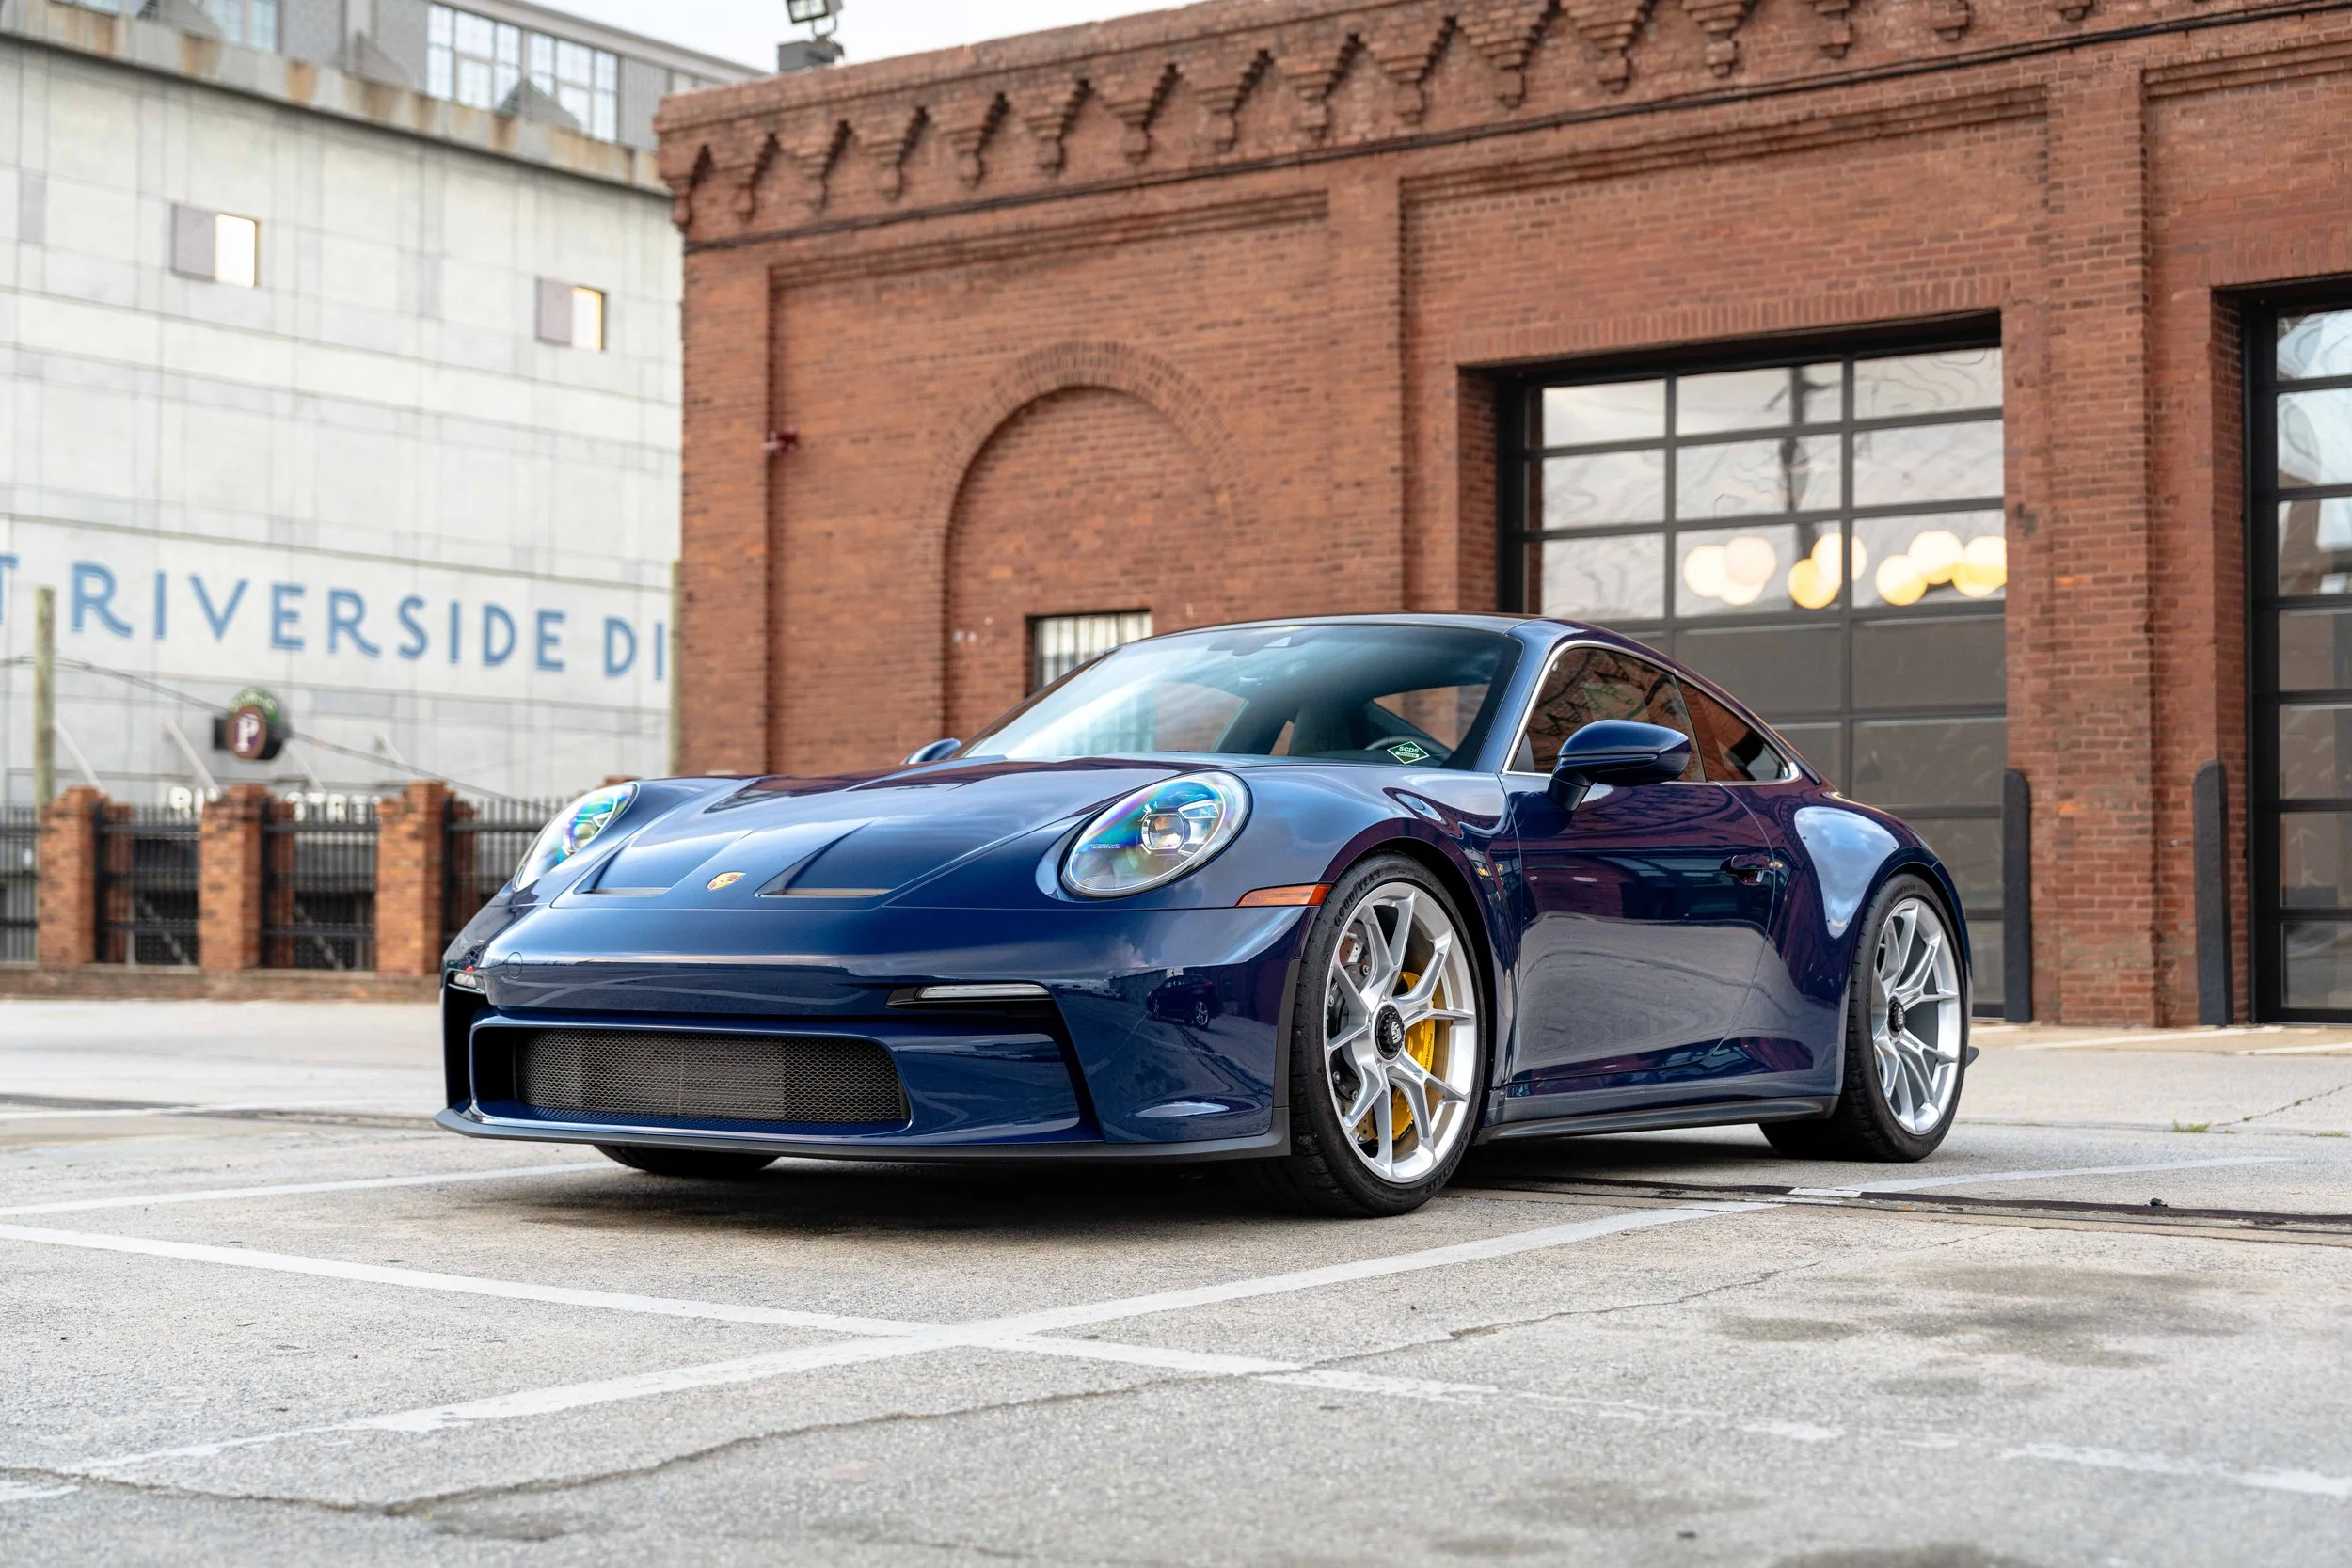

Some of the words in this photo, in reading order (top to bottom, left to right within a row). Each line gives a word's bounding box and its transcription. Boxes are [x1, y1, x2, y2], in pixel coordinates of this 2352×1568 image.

[71, 560, 566, 673] RIVERSIDE
[603, 614, 666, 681] DI
[235, 713, 261, 753] P
[1333, 869, 1381, 927] GOODYEAR
